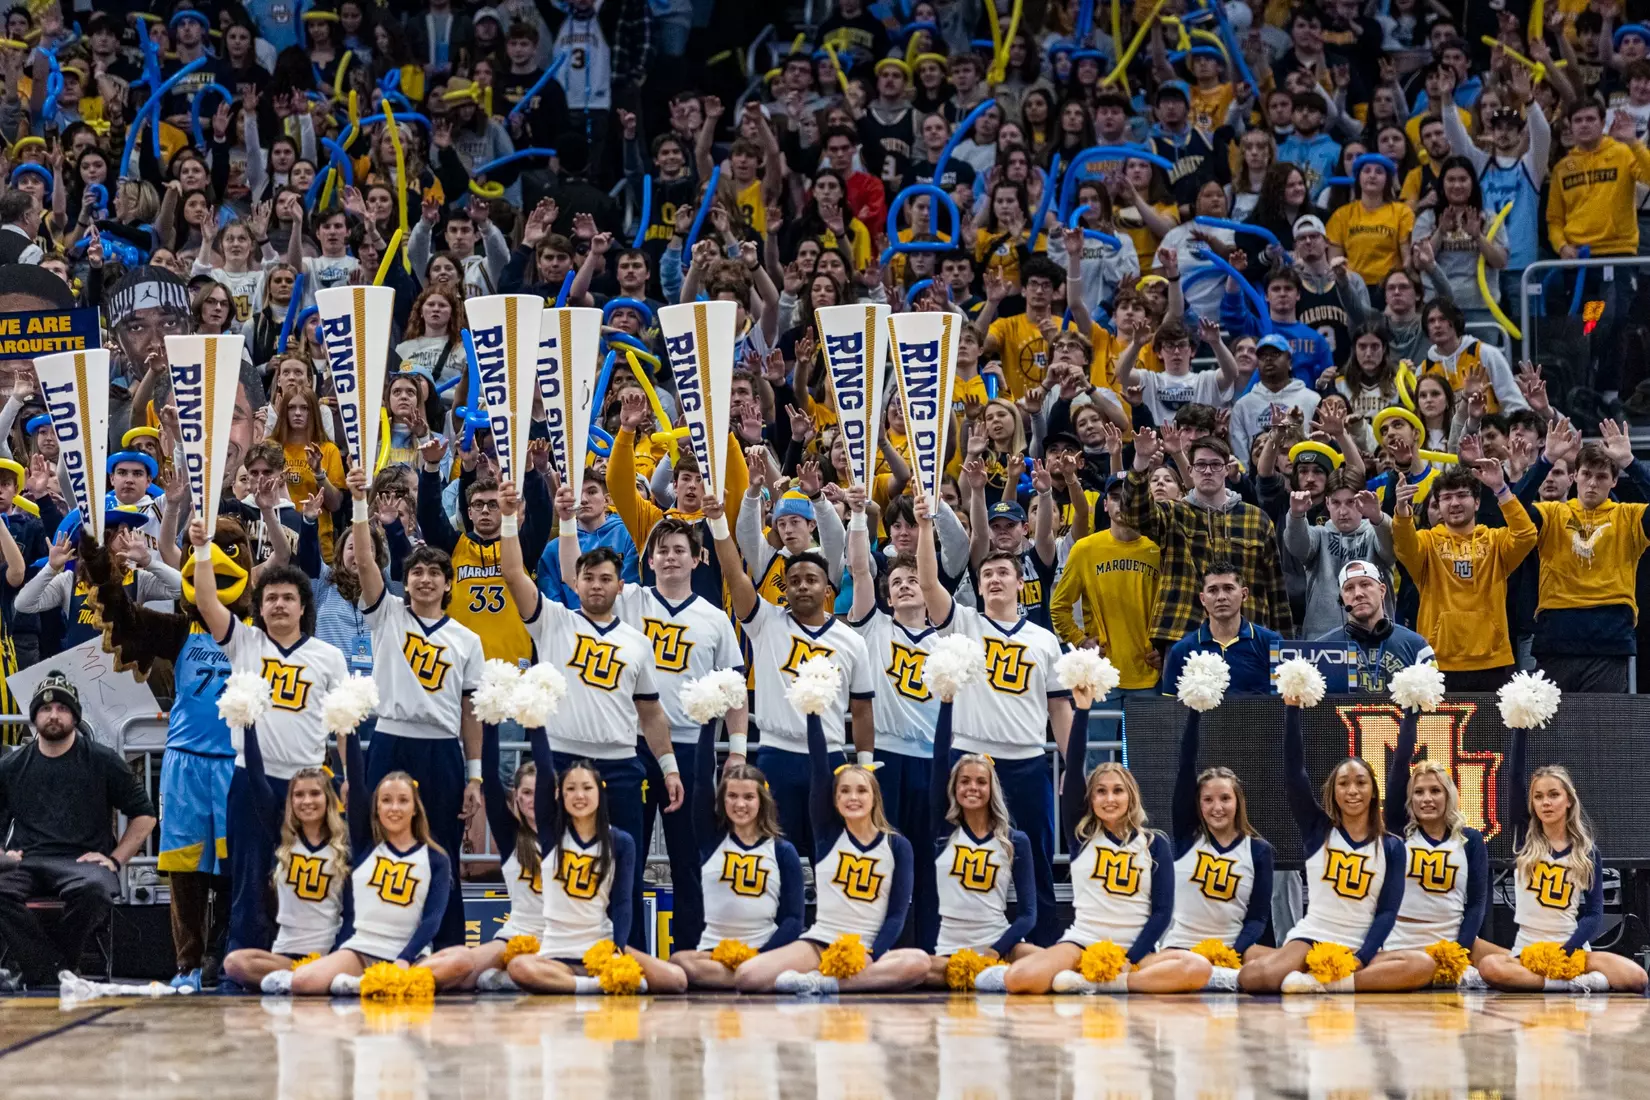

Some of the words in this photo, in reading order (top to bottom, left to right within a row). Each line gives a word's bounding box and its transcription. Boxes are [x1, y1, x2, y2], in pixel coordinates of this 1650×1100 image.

[572, 49, 584, 69] 3
[27, 316, 71, 333] ARE
[322, 313, 356, 394] RING
[341, 403, 360, 465] OUT
[537, 338, 560, 399] OUT
[826, 332, 864, 410] RING
[899, 340, 939, 420] RING
[42, 382, 79, 442] OUT
[171, 363, 204, 443] RING
[472, 325, 507, 406] RING
[492, 416, 511, 480] OUT
[666, 331, 702, 412] RING
[689, 422, 711, 486] OUT
[844, 421, 865, 483] OUT
[915, 431, 936, 496] OUT
[185, 453, 204, 518] OUT
[1096, 558, 1159, 581] MARQUETTE
[1454, 560, 1473, 579] MU
[468, 585, 506, 613] 33
[403, 631, 451, 693] MU
[567, 633, 627, 691] MU
[641, 617, 695, 673] MU
[780, 635, 836, 679] M
[886, 640, 933, 703] MU
[983, 636, 1034, 696] MU
[261, 657, 312, 712] MU
[285, 853, 334, 902] MU
[368, 856, 421, 907] MU
[555, 849, 601, 900] MU
[719, 850, 771, 898] MU
[833, 850, 886, 903] MU
[950, 844, 1000, 893] MU
[1090, 846, 1143, 897] MU
[1189, 850, 1242, 902] MU
[1323, 848, 1375, 900] MU
[1407, 847, 1459, 894] MU
[1526, 861, 1575, 909] MU
